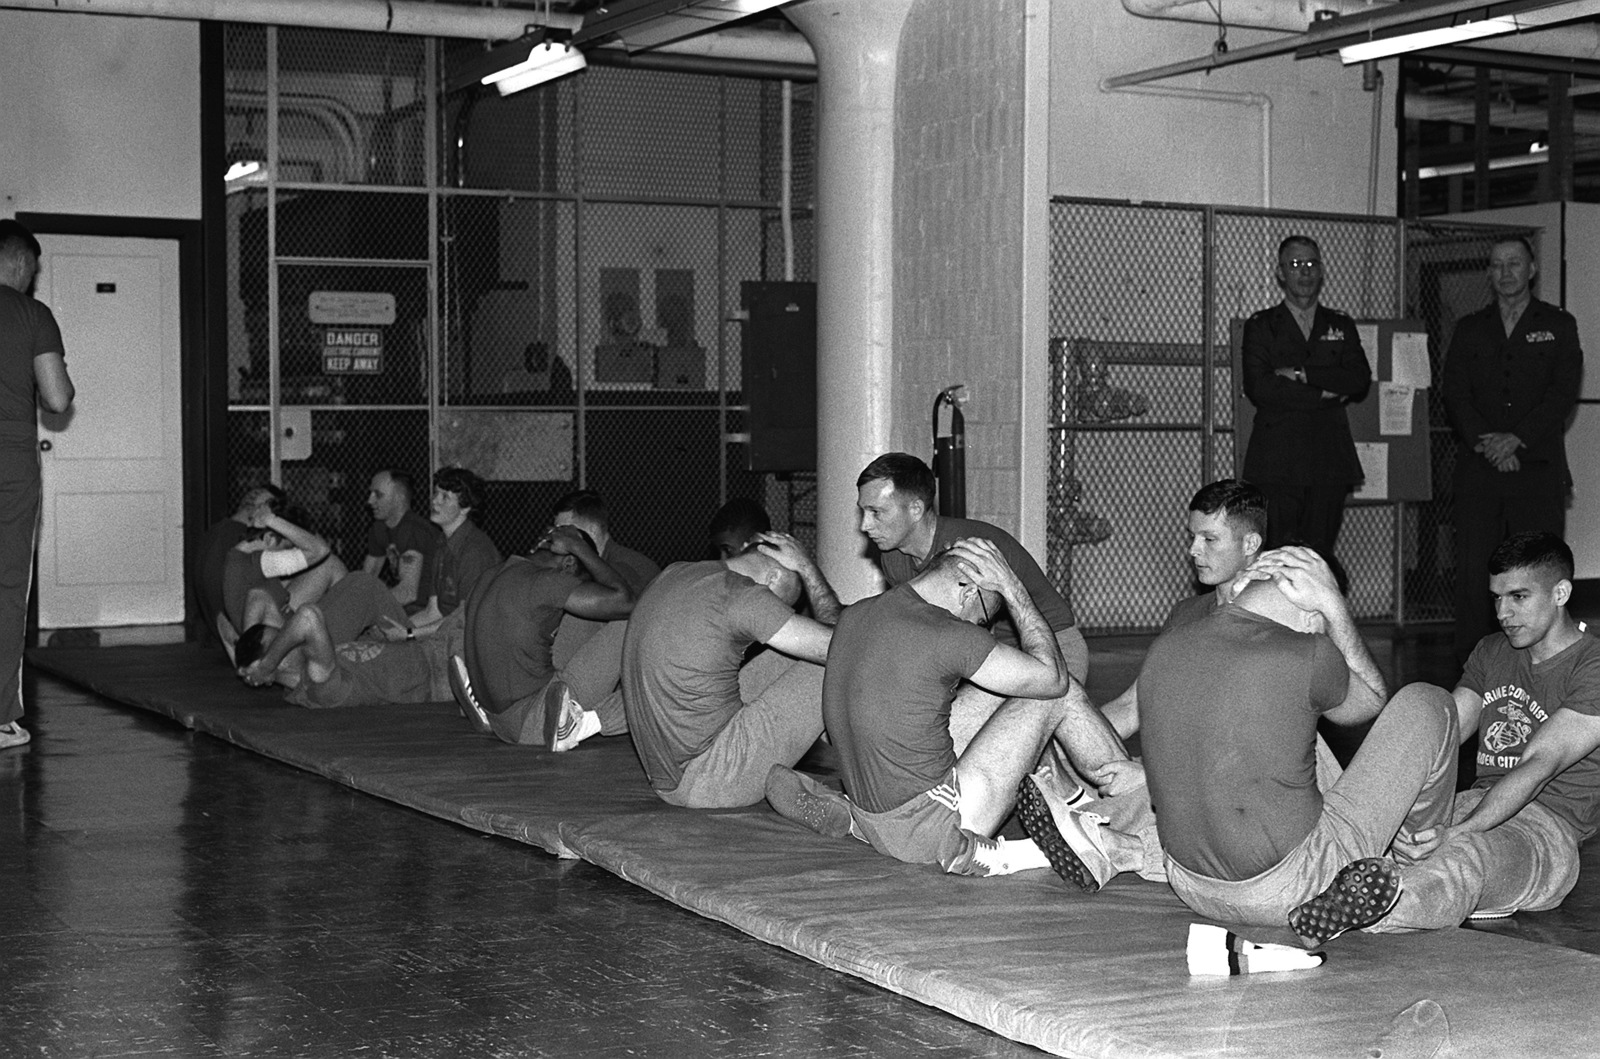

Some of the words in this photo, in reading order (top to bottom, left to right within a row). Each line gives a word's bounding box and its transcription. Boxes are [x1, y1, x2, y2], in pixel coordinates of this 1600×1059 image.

[326, 332, 379, 346] DANGER
[327, 357, 351, 371] KEEP
[353, 358, 380, 371] AWAY
[1482, 685, 1508, 708] ARINE
[1497, 756, 1521, 769] CITY
